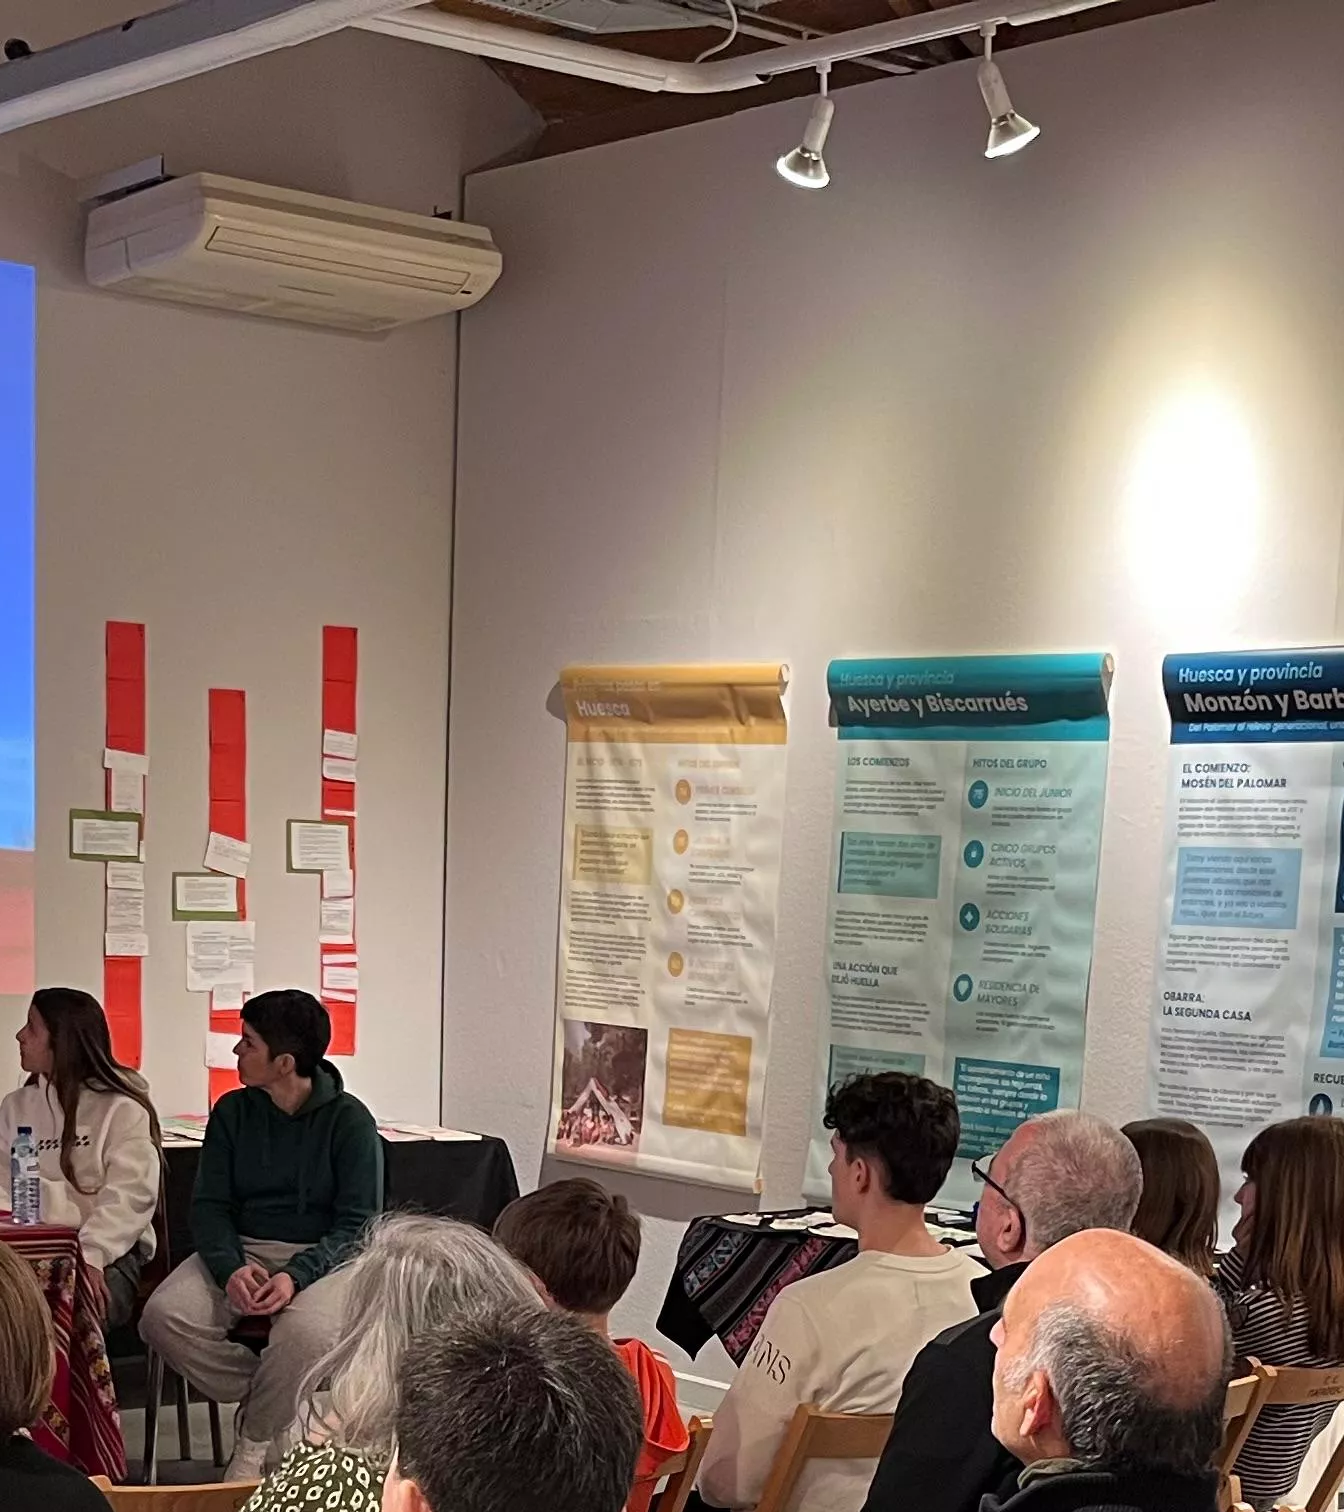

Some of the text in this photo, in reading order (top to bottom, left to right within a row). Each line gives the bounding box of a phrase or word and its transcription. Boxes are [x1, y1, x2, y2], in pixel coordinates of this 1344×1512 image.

[840, 671, 955, 689] Huesca y provincia
[1179, 661, 1323, 685] Huesca y provincia
[576, 700, 630, 717] Huesca
[847, 691, 1028, 718] Ayerbe y Biscarrués
[1184, 688, 1273, 713] Monzón
[1274, 694, 1288, 717] y
[973, 759, 1047, 769] HITOS DEL GRUPO
[1183, 764, 1192, 773] EL
[1219, 779, 1234, 788] DEL
[1237, 779, 1287, 788] PALOMAR
[1163, 1006, 1251, 1021] LA SEGUNDA CASA
